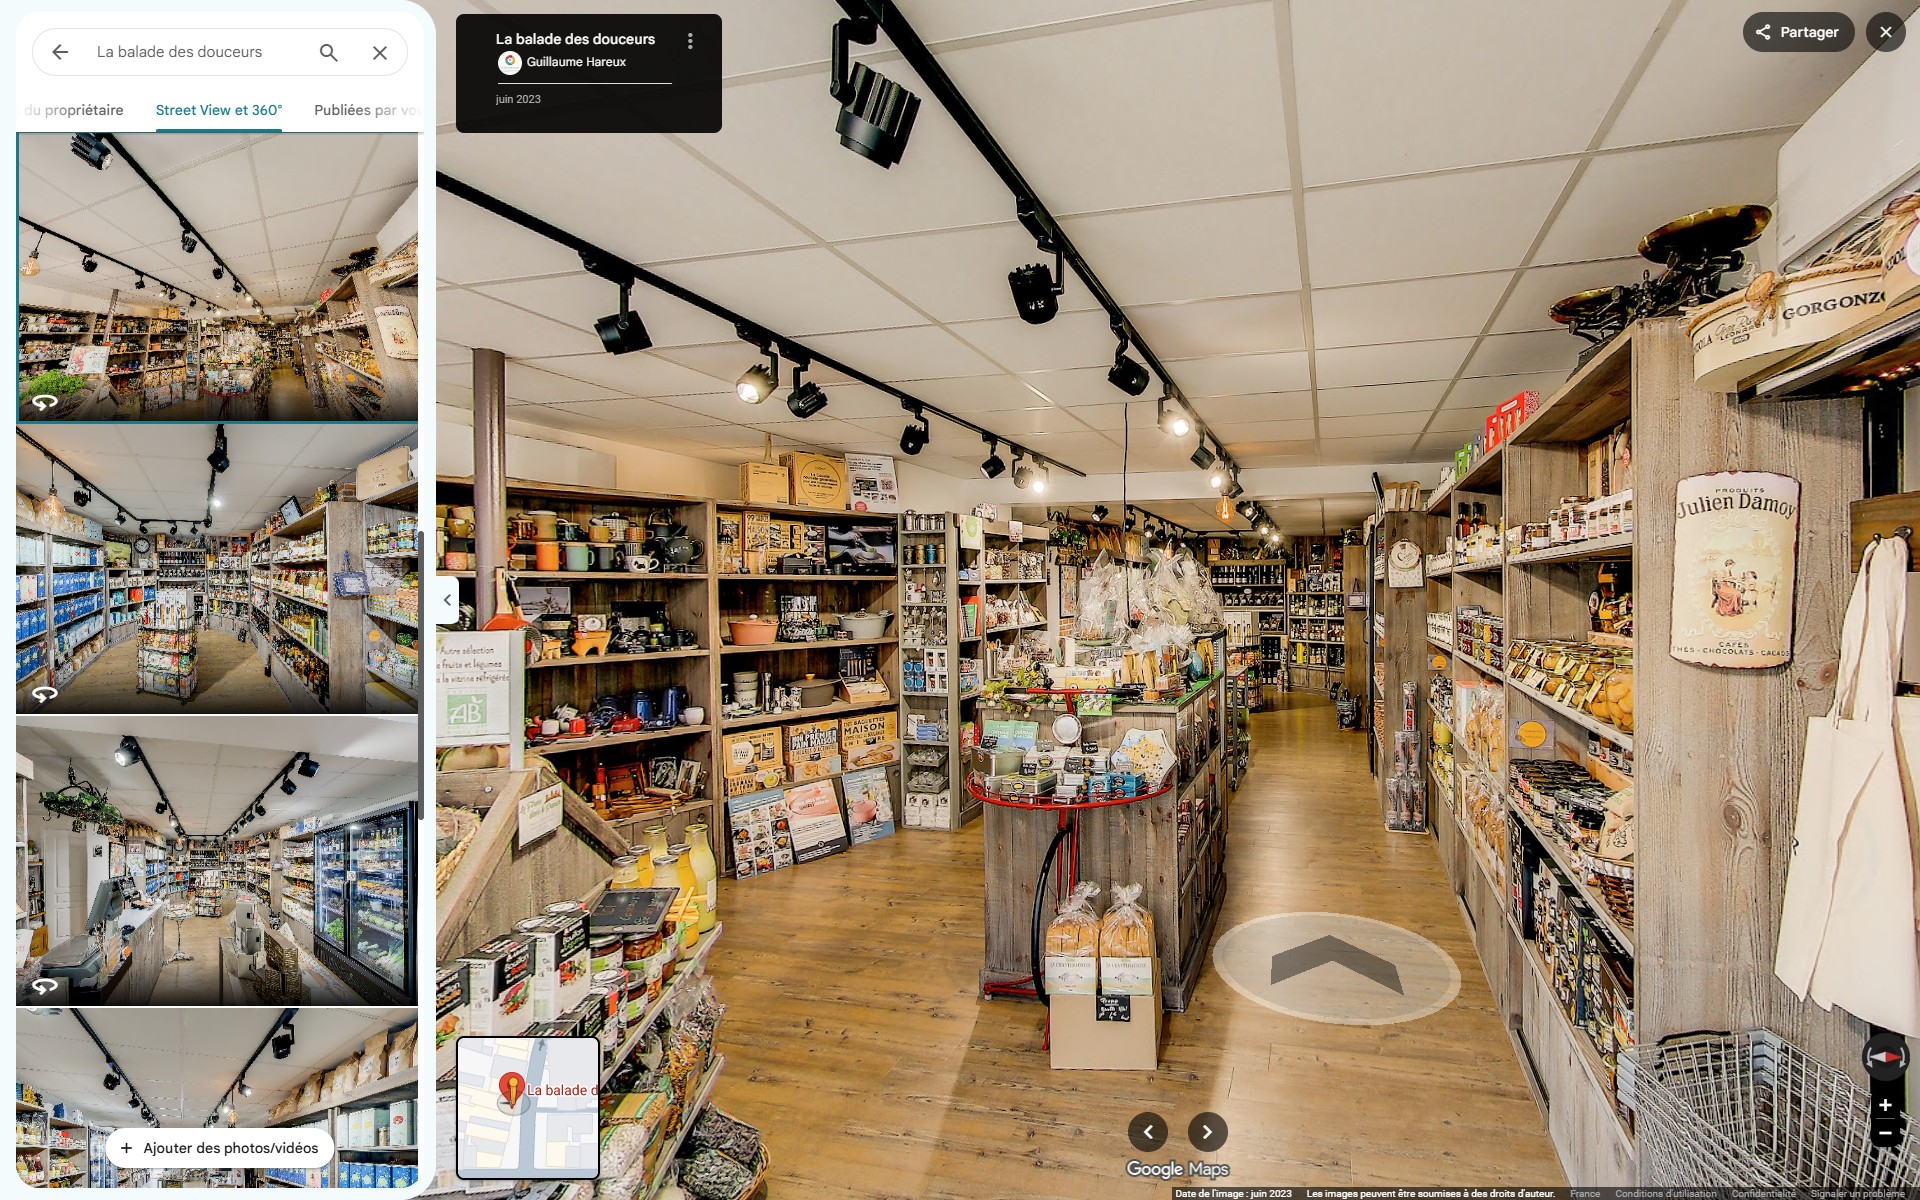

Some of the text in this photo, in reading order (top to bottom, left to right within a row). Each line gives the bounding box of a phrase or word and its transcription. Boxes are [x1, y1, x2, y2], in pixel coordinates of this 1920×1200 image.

[1782, 292, 1886, 320] GORGONZ
[1677, 493, 1797, 520] Julien Damoy
[440, 644, 494, 655] Autre sélection
[1702, 648, 1755, 656] CHOCOLATS
[473, 658, 502, 671] légumes
[844, 722, 885, 735] MAISON
